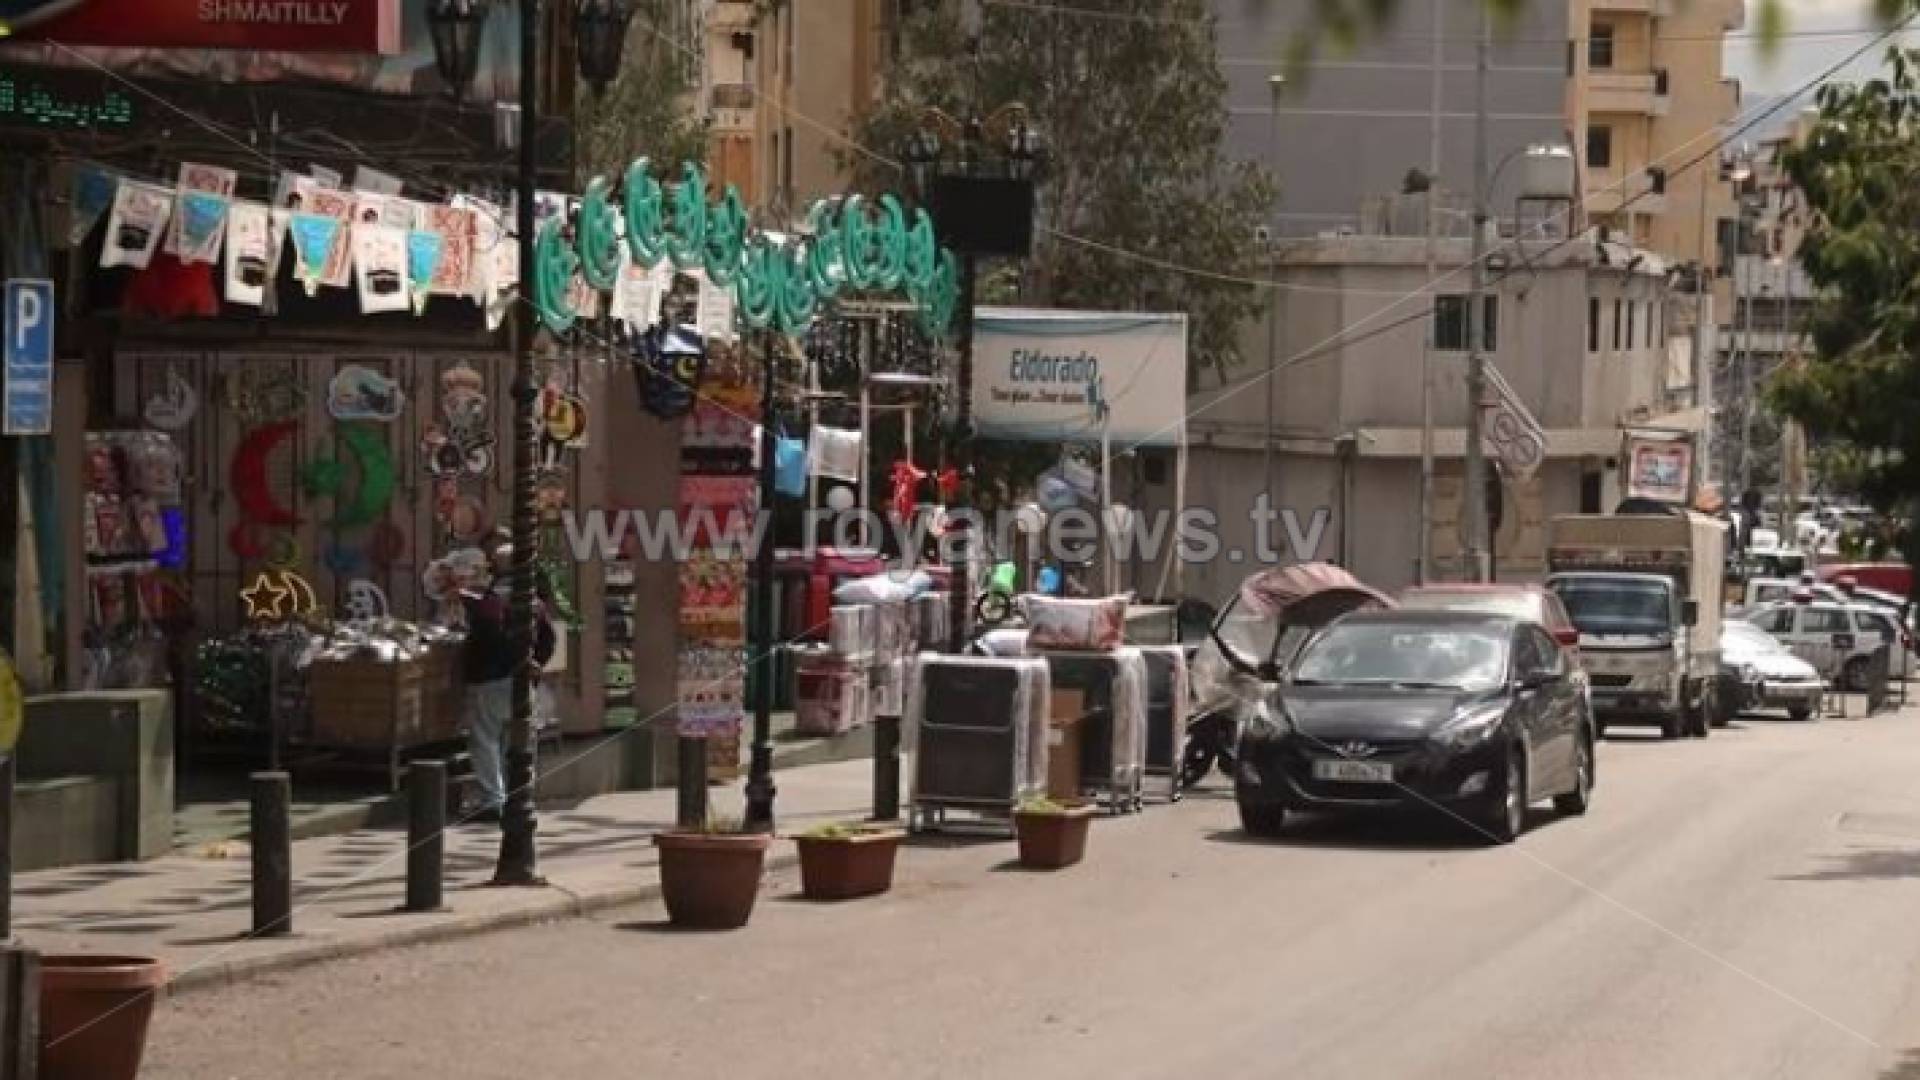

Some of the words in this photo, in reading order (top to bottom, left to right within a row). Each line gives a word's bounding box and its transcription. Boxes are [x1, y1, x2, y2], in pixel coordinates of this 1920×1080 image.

[199, 1, 349, 24] SHMAITILLY
[18, 288, 41, 348] P
[1010, 349, 1096, 382] Eldorado
